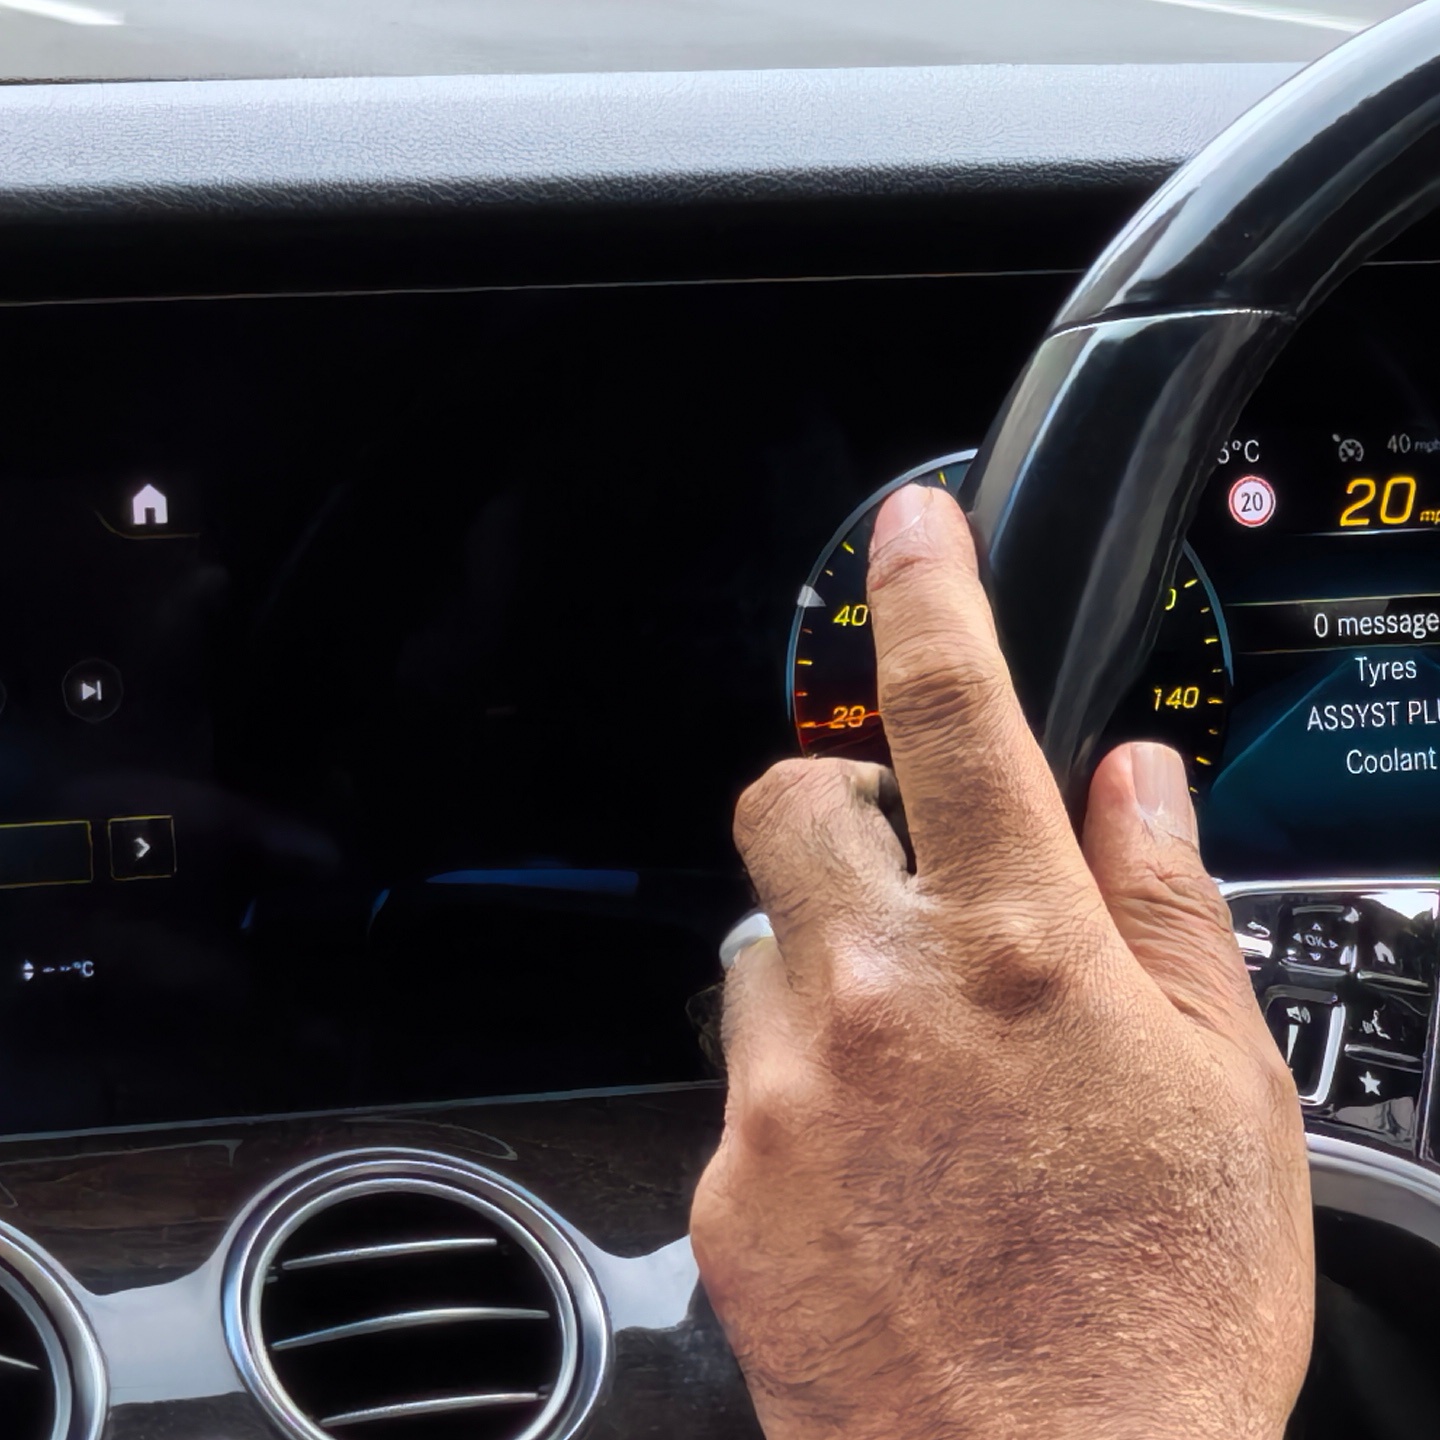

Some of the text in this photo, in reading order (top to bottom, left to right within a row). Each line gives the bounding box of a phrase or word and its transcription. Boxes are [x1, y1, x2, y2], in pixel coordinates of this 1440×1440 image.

[1387, 433, 1410, 454] 40
[1240, 491, 1264, 513] 20
[1340, 476, 1417, 527] 20
[832, 604, 869, 627] 40
[1314, 613, 1329, 638] 0
[1354, 656, 1418, 688] Tyres
[1153, 686, 1200, 712] 140
[1306, 700, 1401, 732] ASSYST
[1346, 746, 1438, 775] Coolant
